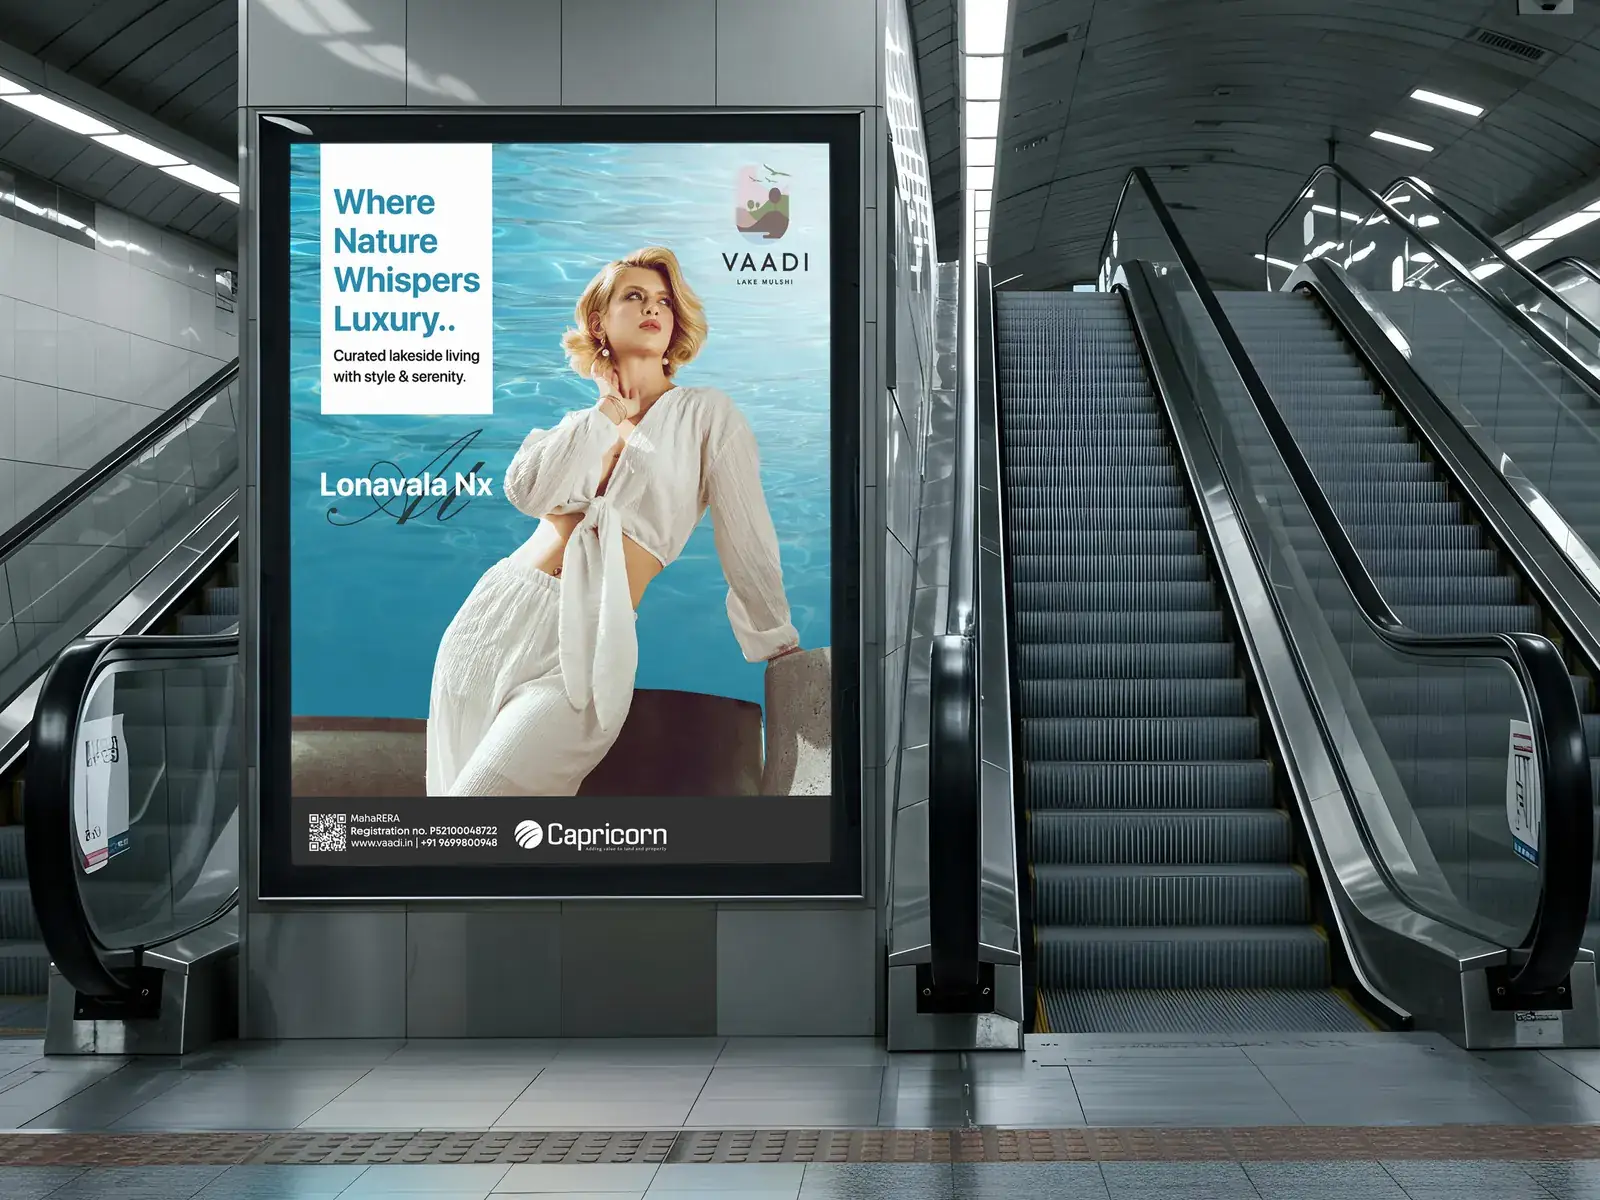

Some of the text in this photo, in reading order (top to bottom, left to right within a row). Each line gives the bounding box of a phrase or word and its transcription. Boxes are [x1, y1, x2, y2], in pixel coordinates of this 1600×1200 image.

[333, 188, 435, 215] Where
[334, 227, 438, 254] Nature
[721, 252, 809, 272] VAADI
[333, 265, 481, 299] Whispers
[736, 278, 793, 286] LAKE MULSHI
[334, 305, 456, 338] Luxury..
[333, 348, 480, 365] Curated lakeside living
[333, 369, 466, 386] with style & serenity.
[320, 472, 493, 497] Lonavala Nx
[350, 813, 401, 823] MahaRERA
[350, 826, 498, 838] Registration no. P52100048722
[547, 822, 668, 852] Capricorn
[350, 838, 413, 848] www.vaadi.in
[421, 838, 437, 848] +91
[438, 838, 498, 848] 9699800948
